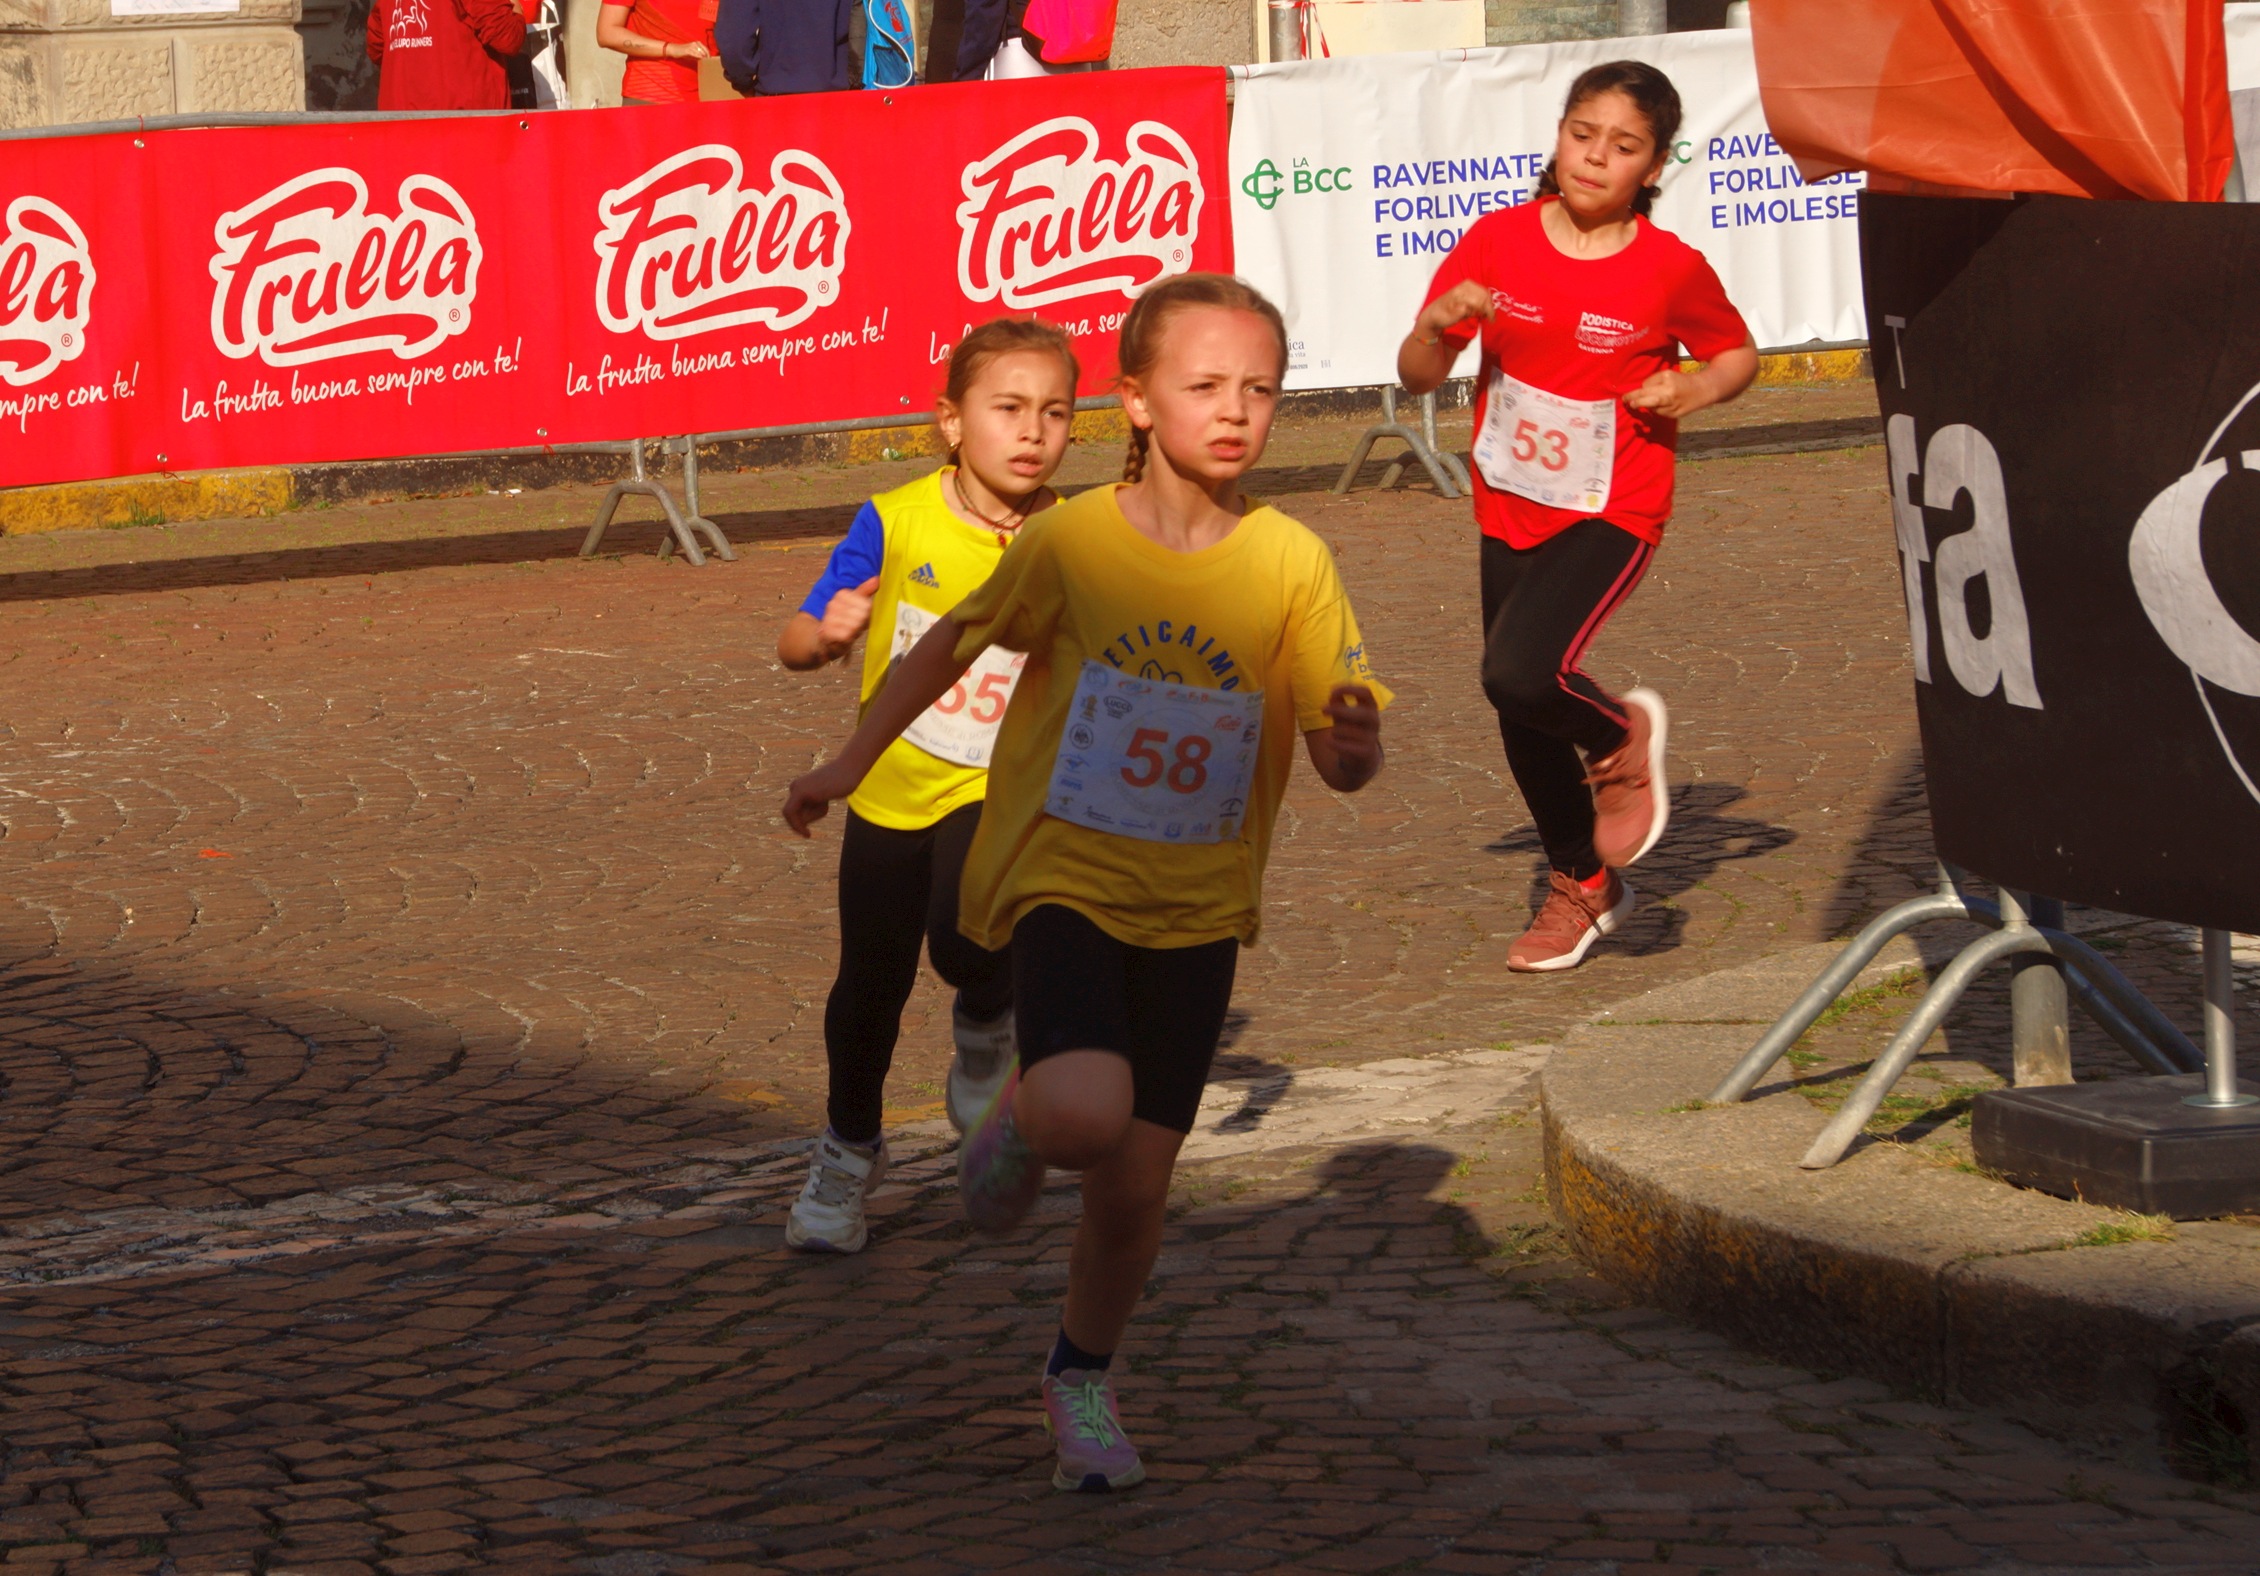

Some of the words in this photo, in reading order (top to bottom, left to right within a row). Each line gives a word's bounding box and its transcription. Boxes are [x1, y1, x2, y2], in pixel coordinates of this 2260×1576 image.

[411, 36, 433, 48] RUNNERS
[1293, 157, 1309, 168] LA
[1293, 166, 1353, 194] BCC
[1372, 152, 1544, 189] RAVENNATE
[966, 128, 1195, 290] Frulla
[1711, 204, 1729, 229] E
[1736, 194, 1858, 227] IMOLESE
[604, 156, 841, 320] Frulla
[1376, 233, 1393, 258] E
[220, 179, 473, 345] Frulla
[1579, 311, 1634, 331] PODISTICA
[566, 362, 592, 396] La
[597, 353, 665, 395] frutta
[671, 342, 737, 377] buona
[741, 338, 816, 377] sempre
[821, 331, 858, 352] con
[862, 306, 889, 343] te!
[66, 384, 109, 406] con
[112, 360, 140, 400] te!
[181, 387, 209, 423] La
[213, 379, 284, 422] frutta
[290, 370, 361, 405] buona
[367, 367, 446, 406] sempre
[452, 358, 489, 381] con
[493, 336, 522, 375] te!
[1511, 418, 1570, 472] 53
[1119, 727, 1213, 795] 58
